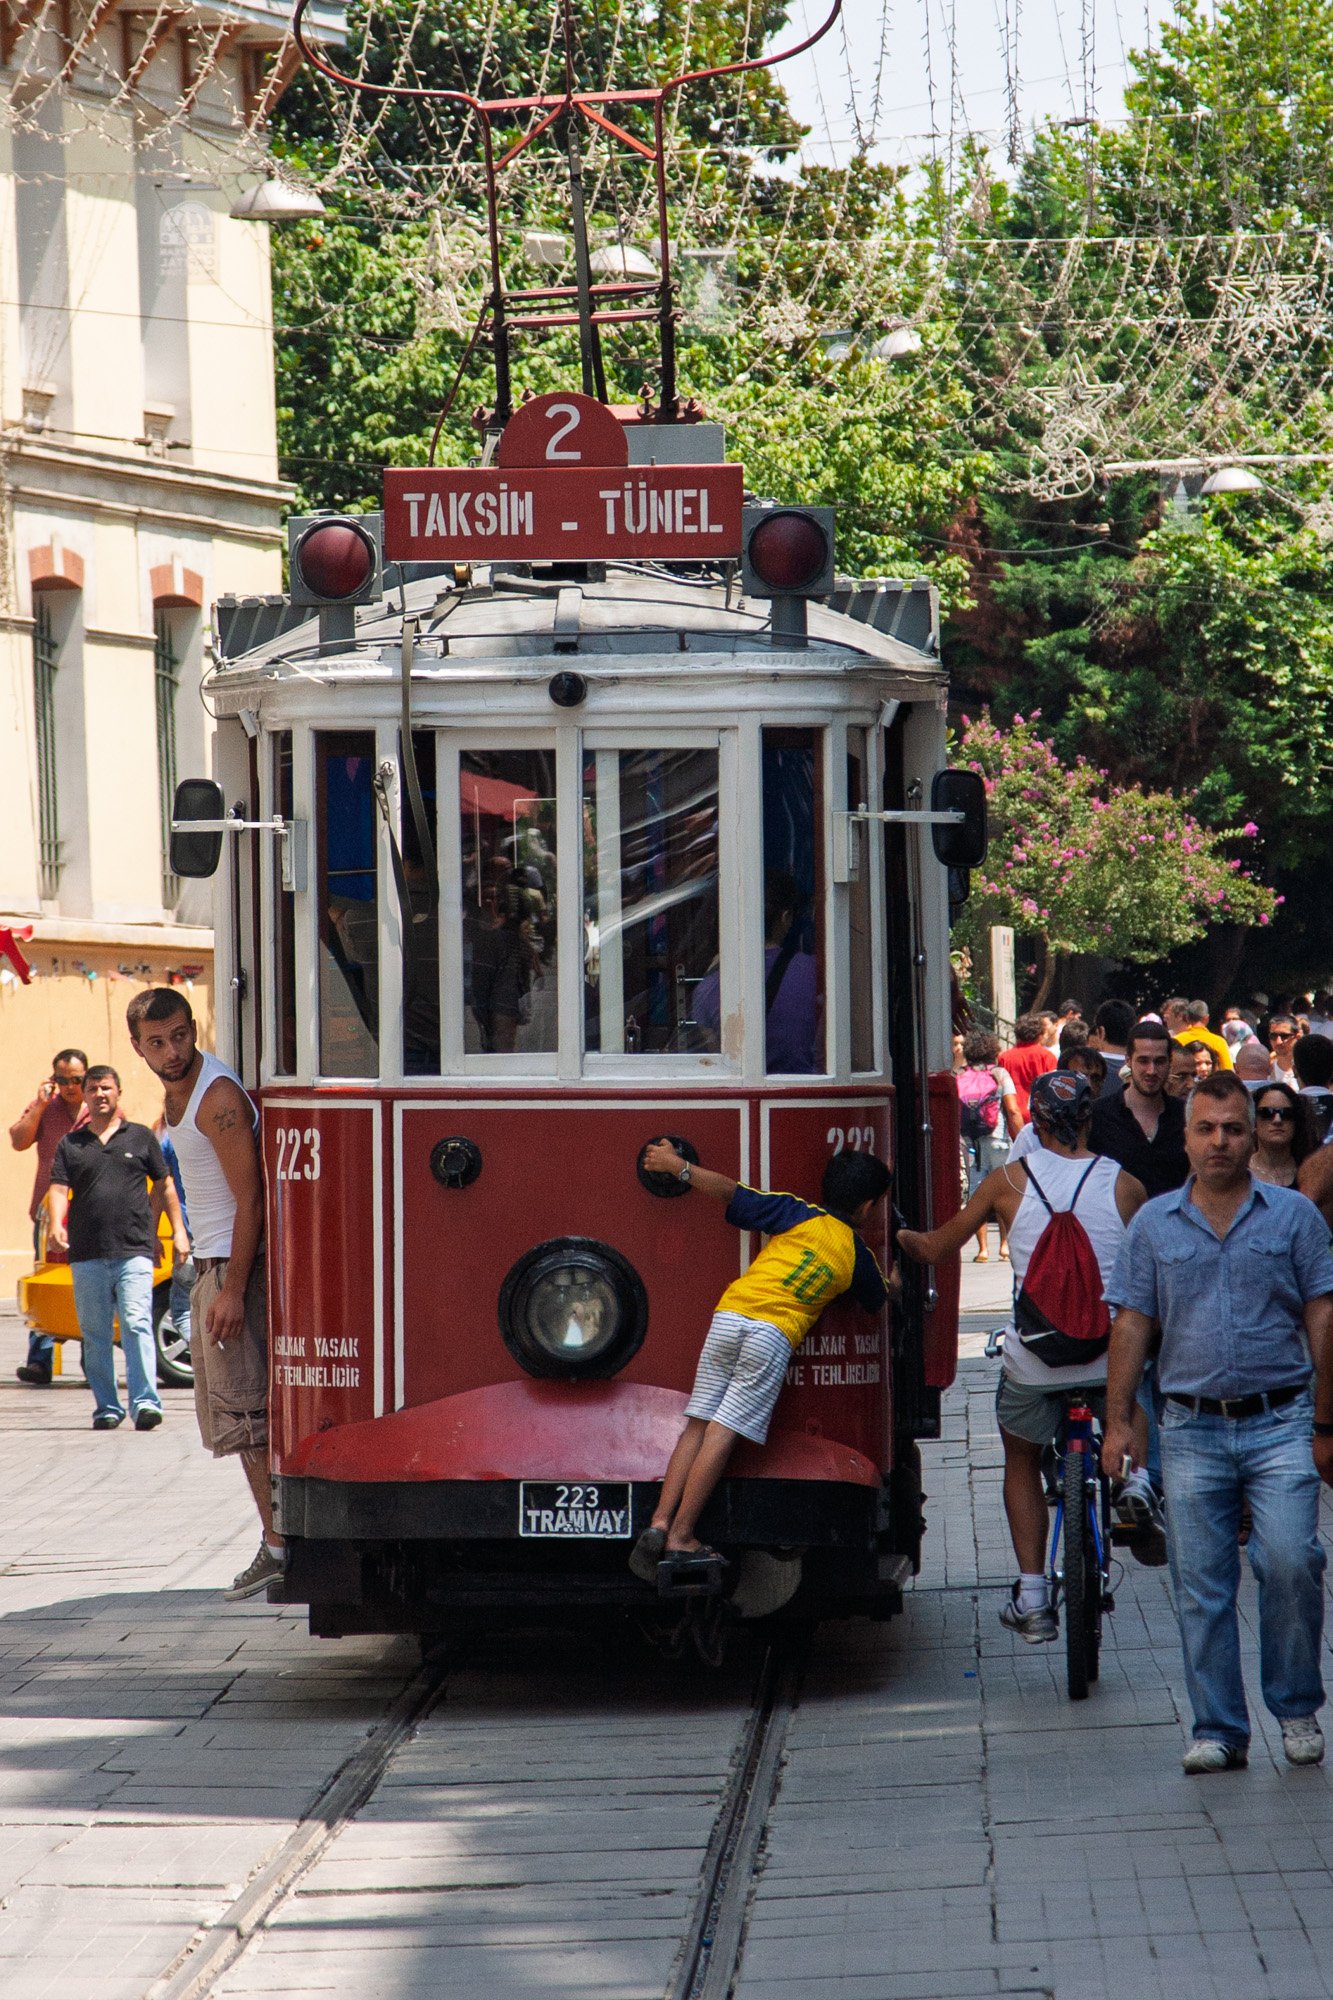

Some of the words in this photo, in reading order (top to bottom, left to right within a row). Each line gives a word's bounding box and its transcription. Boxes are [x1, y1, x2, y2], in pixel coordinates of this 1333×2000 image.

[545, 403, 582, 460] 2
[403, 483, 534, 537] TAKSİM
[599, 481, 723, 535] TÜNEL
[276, 1128, 321, 1181] 223
[780, 1249, 834, 1305] 10
[314, 1337, 359, 1358] YASAK
[527, 1510, 626, 1533] TRAMVAY
[555, 1485, 599, 1509] 223
